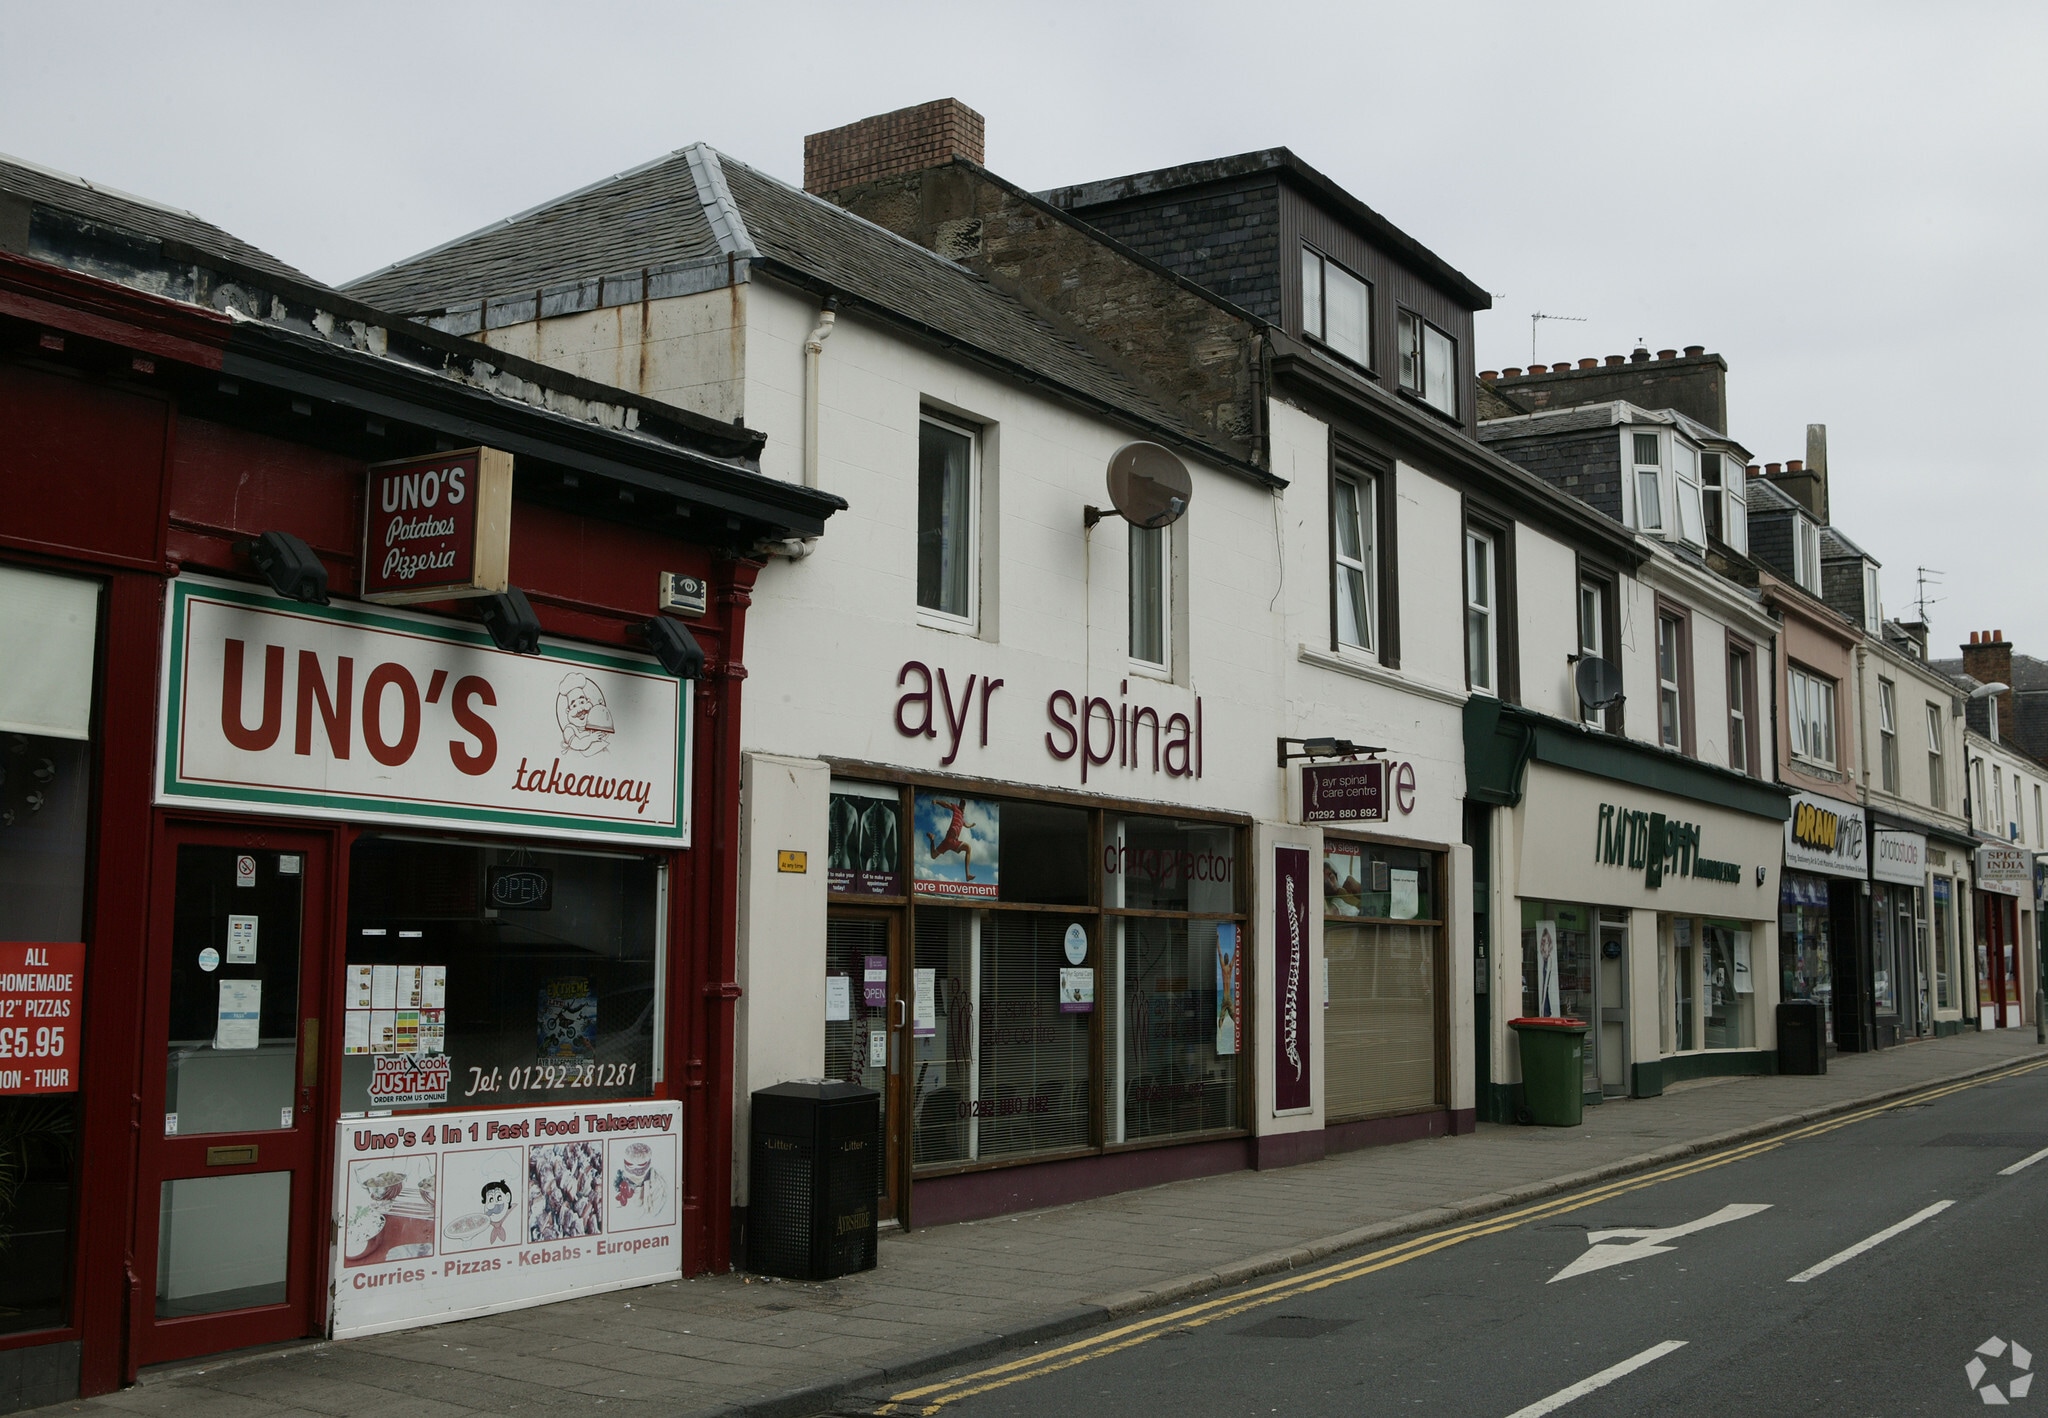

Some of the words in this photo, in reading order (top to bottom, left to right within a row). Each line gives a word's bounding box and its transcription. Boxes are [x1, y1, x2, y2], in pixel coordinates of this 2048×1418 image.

[382, 467, 465, 513] UNO'S
[385, 514, 454, 547] Potatoes
[382, 542, 456, 579] Pizzeria
[221, 638, 498, 776] UNO'S
[895, 660, 1005, 765] ayr
[1046, 679, 1204, 784] spinal
[511, 757, 653, 813] takeaway
[1322, 778, 1337, 788] ayr
[1340, 774, 1368, 787] spinal
[1322, 789, 1344, 798] care
[1346, 787, 1377, 797] centre
[1309, 810, 1335, 819] 01292
[1339, 809, 1357, 818] 880
[1360, 808, 1378, 817] 892
[1792, 800, 1838, 855] DRAW
[1338, 844, 1360, 855] sleep
[1988, 851, 2024, 860] SPICE
[1104, 836, 1235, 888] chiropractor
[1987, 861, 2024, 869] INDIA
[497, 877, 544, 900] OPEN
[939, 883, 996, 896] movement
[25, 948, 49, 966] ALL
[864, 988, 885, 999] OPEN
[25, 999, 70, 1018] PIZZAS
[0, 1027, 65, 1058] £5.95
[377, 1056, 407, 1071] Don't
[419, 1057, 448, 1070] cook
[34, 1068, 69, 1087] THUR
[372, 1072, 414, 1092] JUST
[417, 1072, 448, 1090] EAT
[508, 1065, 565, 1090] 01292
[571, 1062, 637, 1088] 281281
[373, 1095, 394, 1103] ORDER
[395, 1094, 413, 1102] FROM
[424, 1093, 445, 1101] ONLINE
[354, 1128, 416, 1150] Uno's
[422, 1126, 436, 1145] 4
[442, 1124, 462, 1144] In
[468, 1122, 479, 1142] 1
[487, 1119, 530, 1140] Fast
[534, 1116, 580, 1137] Food
[584, 1113, 673, 1132] Takeaway
[768, 1139, 792, 1151] Litter
[844, 1141, 864, 1152] Litter
[353, 1268, 426, 1290] Curries
[444, 1257, 501, 1278] Pizzas
[518, 1246, 581, 1267] Kebabs
[596, 1235, 670, 1256] European
